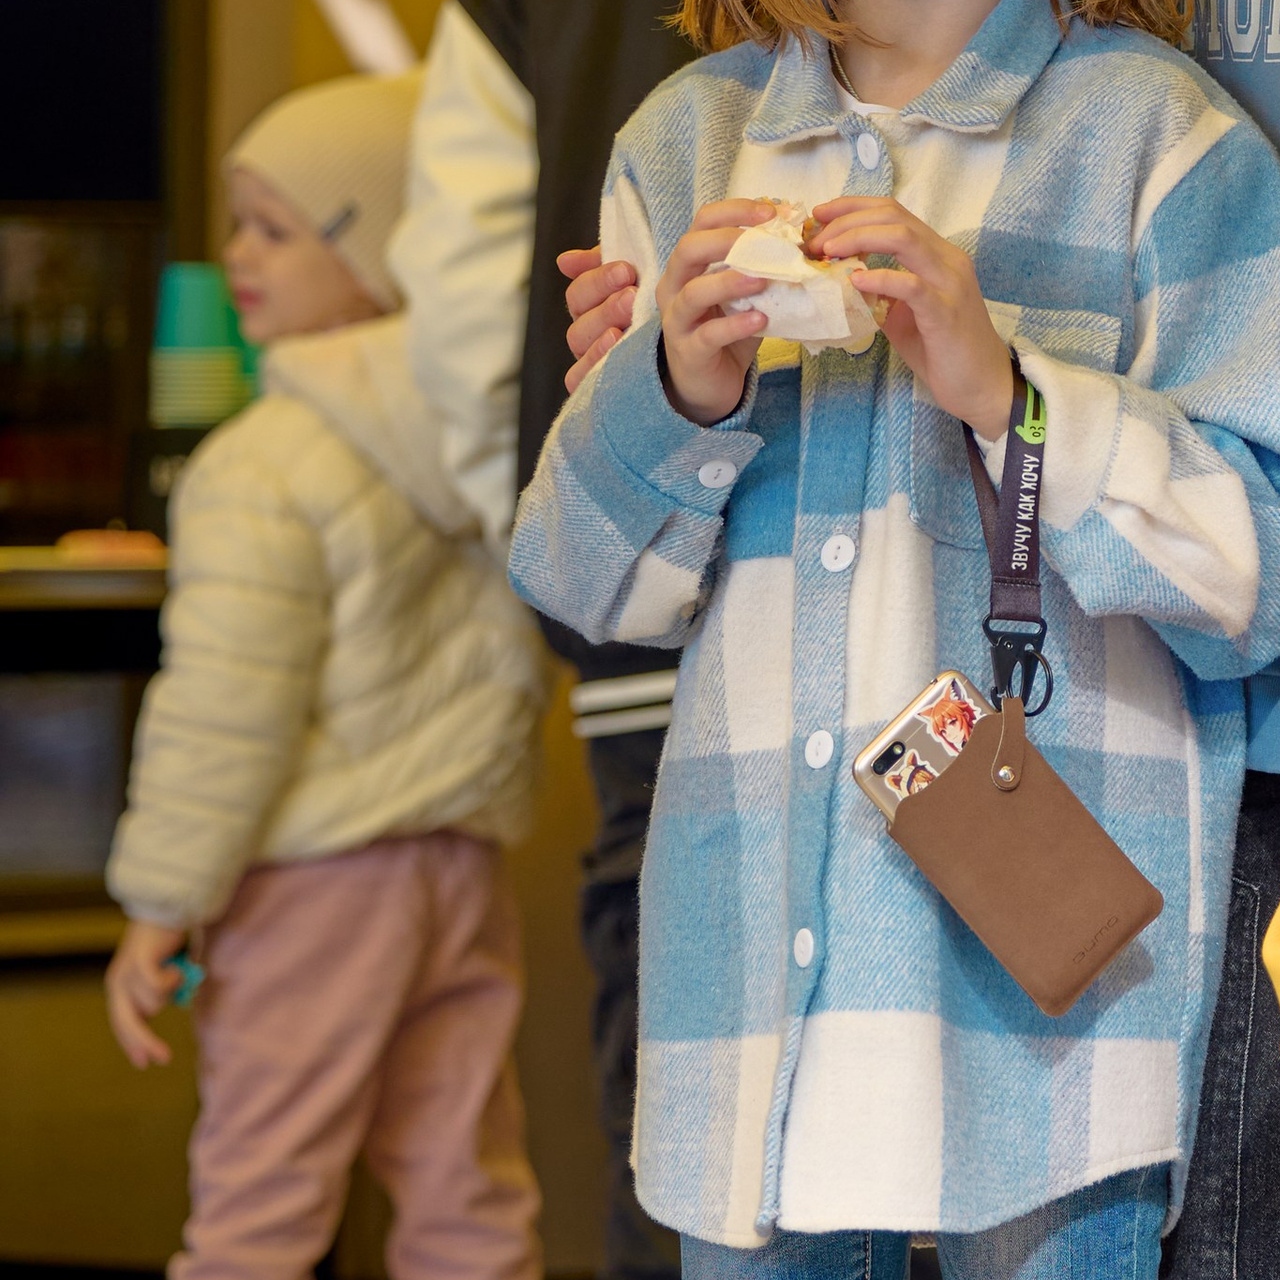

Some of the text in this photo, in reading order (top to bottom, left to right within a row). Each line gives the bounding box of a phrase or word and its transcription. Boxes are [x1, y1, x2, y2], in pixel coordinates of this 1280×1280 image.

[1011, 453, 1040, 571] ЗВУЧУ КАК ХОЧУ
